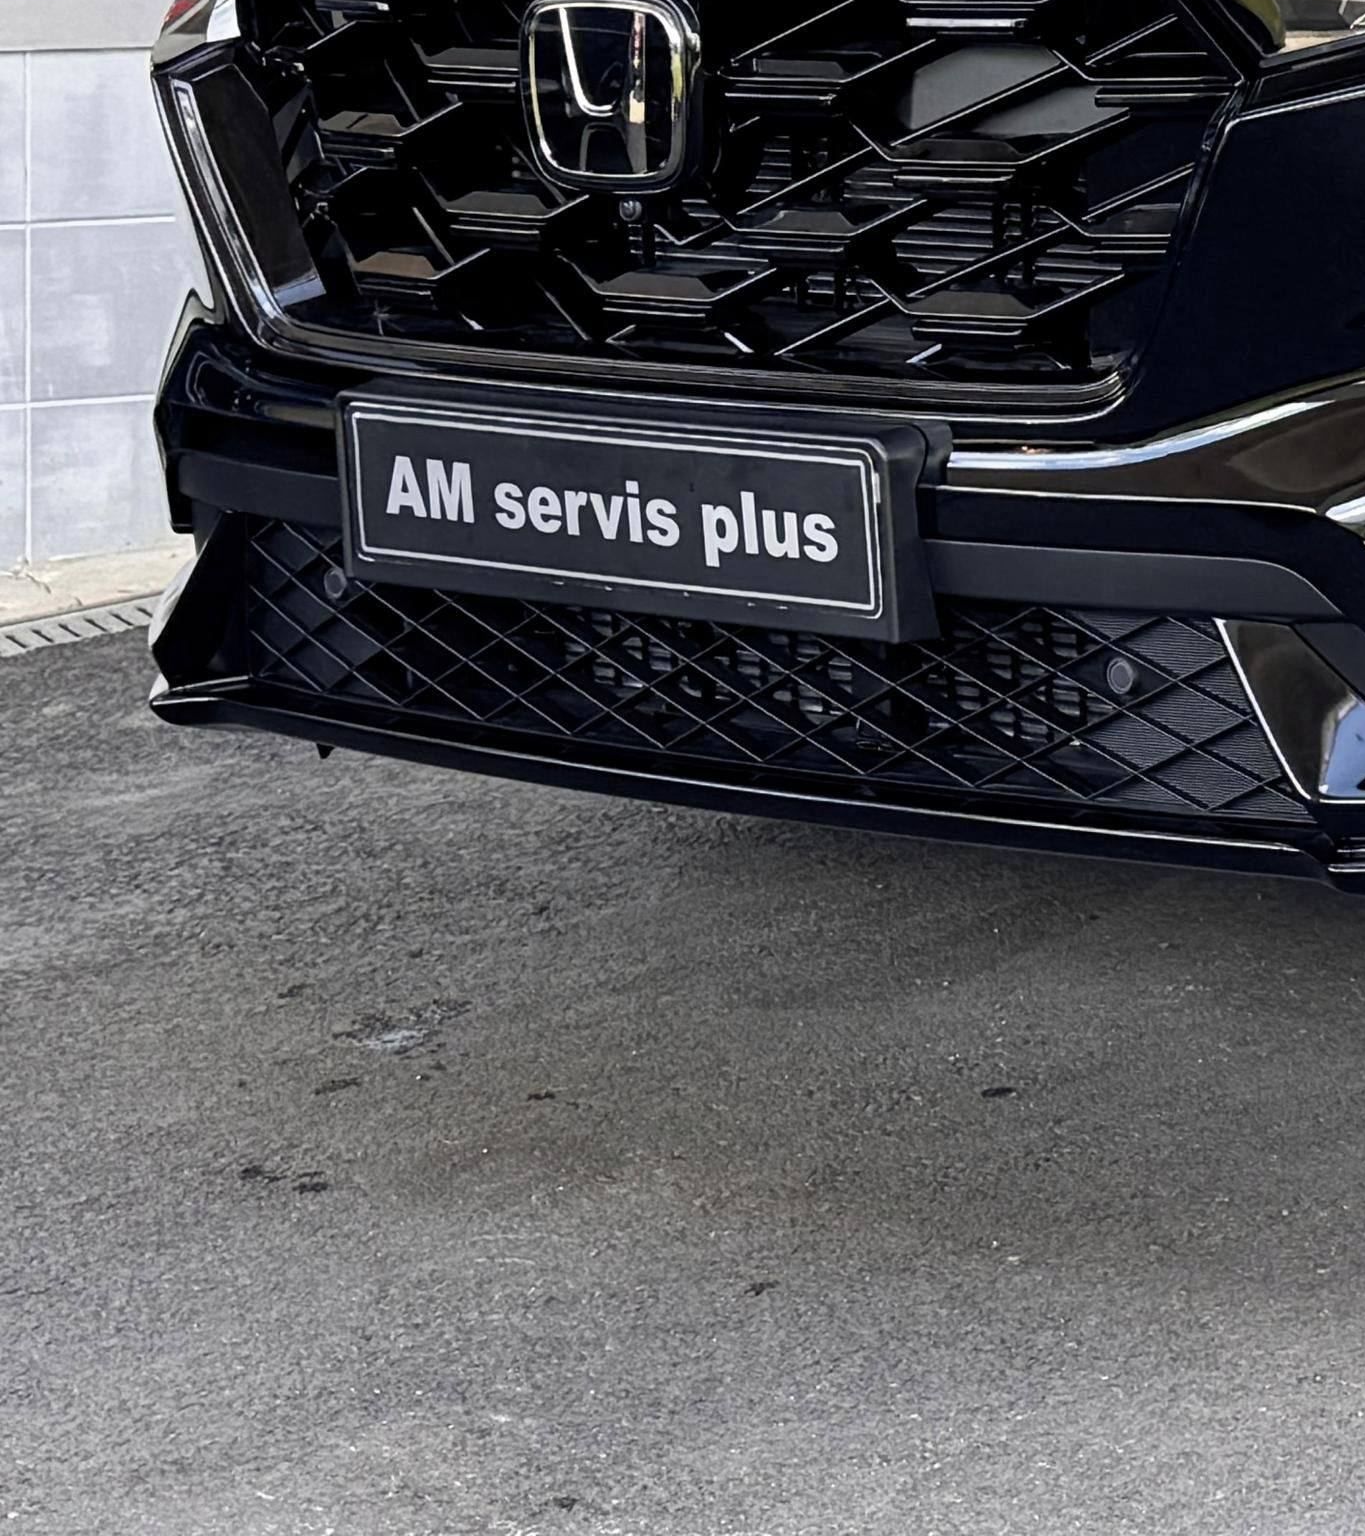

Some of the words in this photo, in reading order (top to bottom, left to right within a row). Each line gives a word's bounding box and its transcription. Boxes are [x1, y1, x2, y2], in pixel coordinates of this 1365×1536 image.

[386, 455, 475, 524] AM
[494, 480, 681, 547] servis
[701, 491, 839, 568] plus
